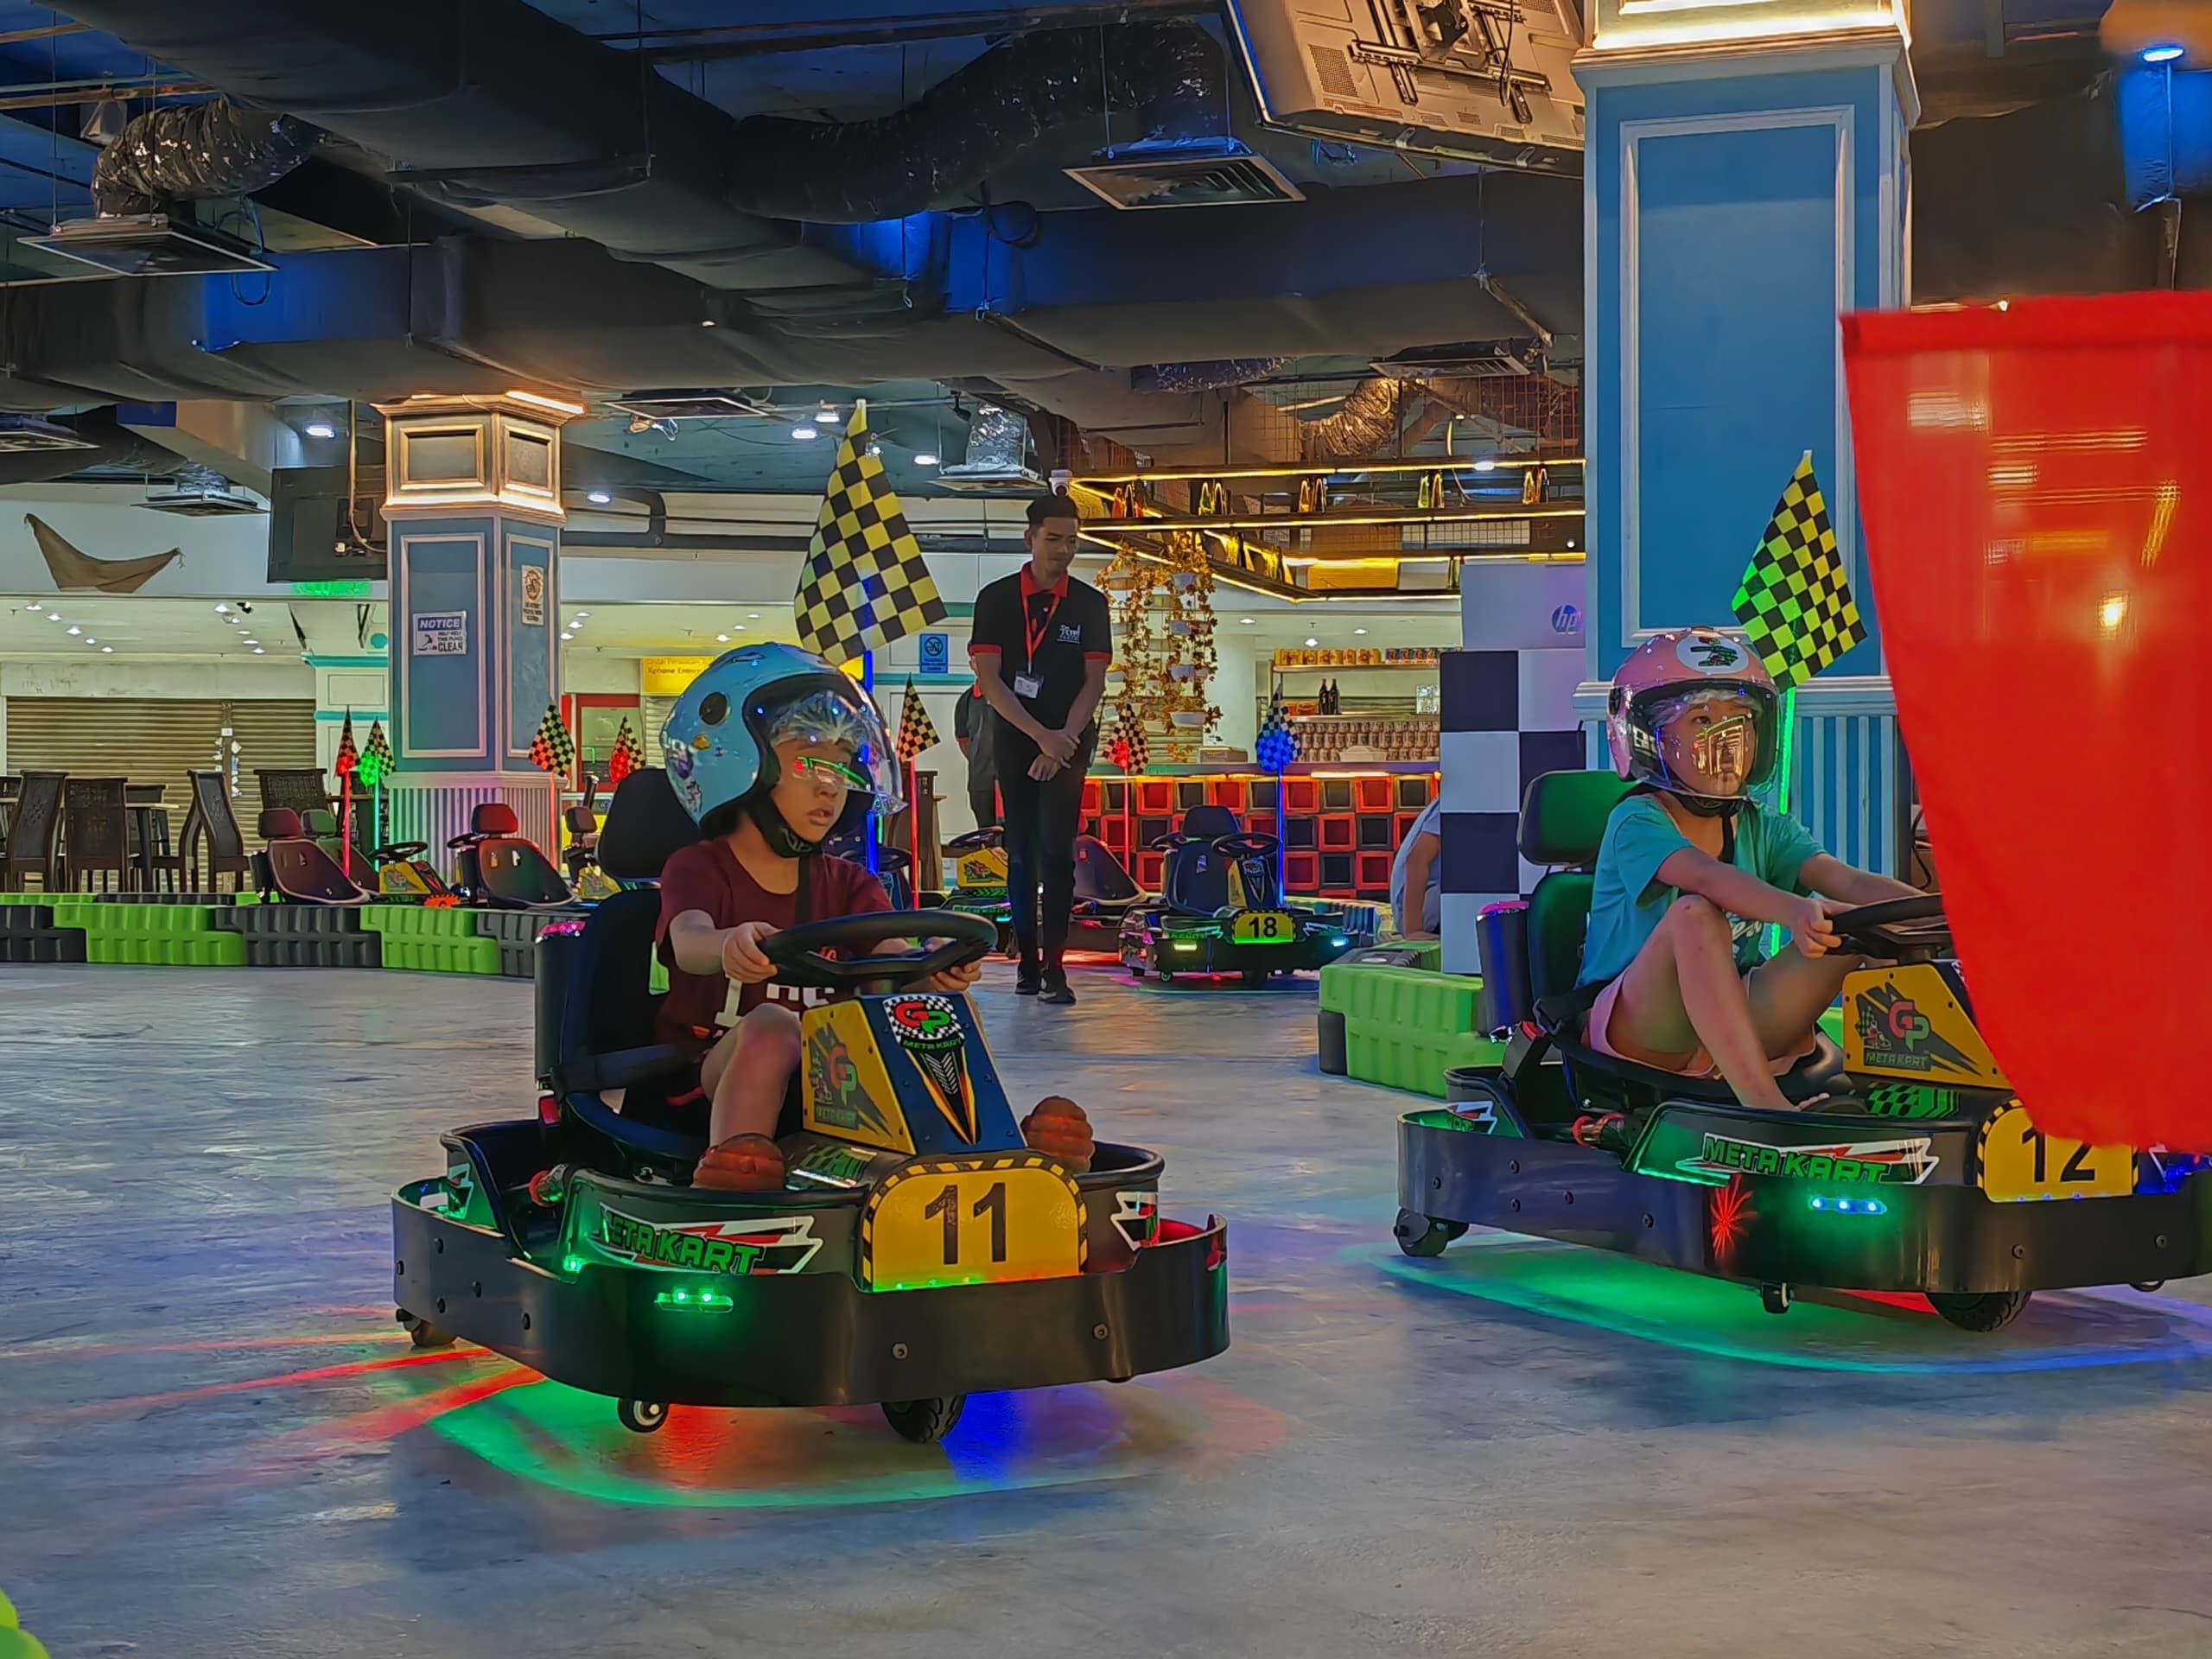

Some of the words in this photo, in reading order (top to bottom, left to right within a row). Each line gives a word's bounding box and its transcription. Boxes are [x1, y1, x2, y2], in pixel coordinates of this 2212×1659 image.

[420, 619, 461, 628] NOTICE
[1554, 604, 1577, 632] hp
[438, 642, 463, 652] CLEAN
[1249, 917, 1277, 938] 18
[893, 1001, 951, 1037] GP
[1889, 1001, 1930, 1052] GP
[830, 1046, 857, 1106] GP
[1705, 1137, 1777, 1173] META
[1784, 1153, 1887, 1183] KART
[2022, 1127, 2095, 1183] 12
[607, 1217, 655, 1256] ETA
[658, 1230, 760, 1274] KART
[925, 1182, 1006, 1265] 11
